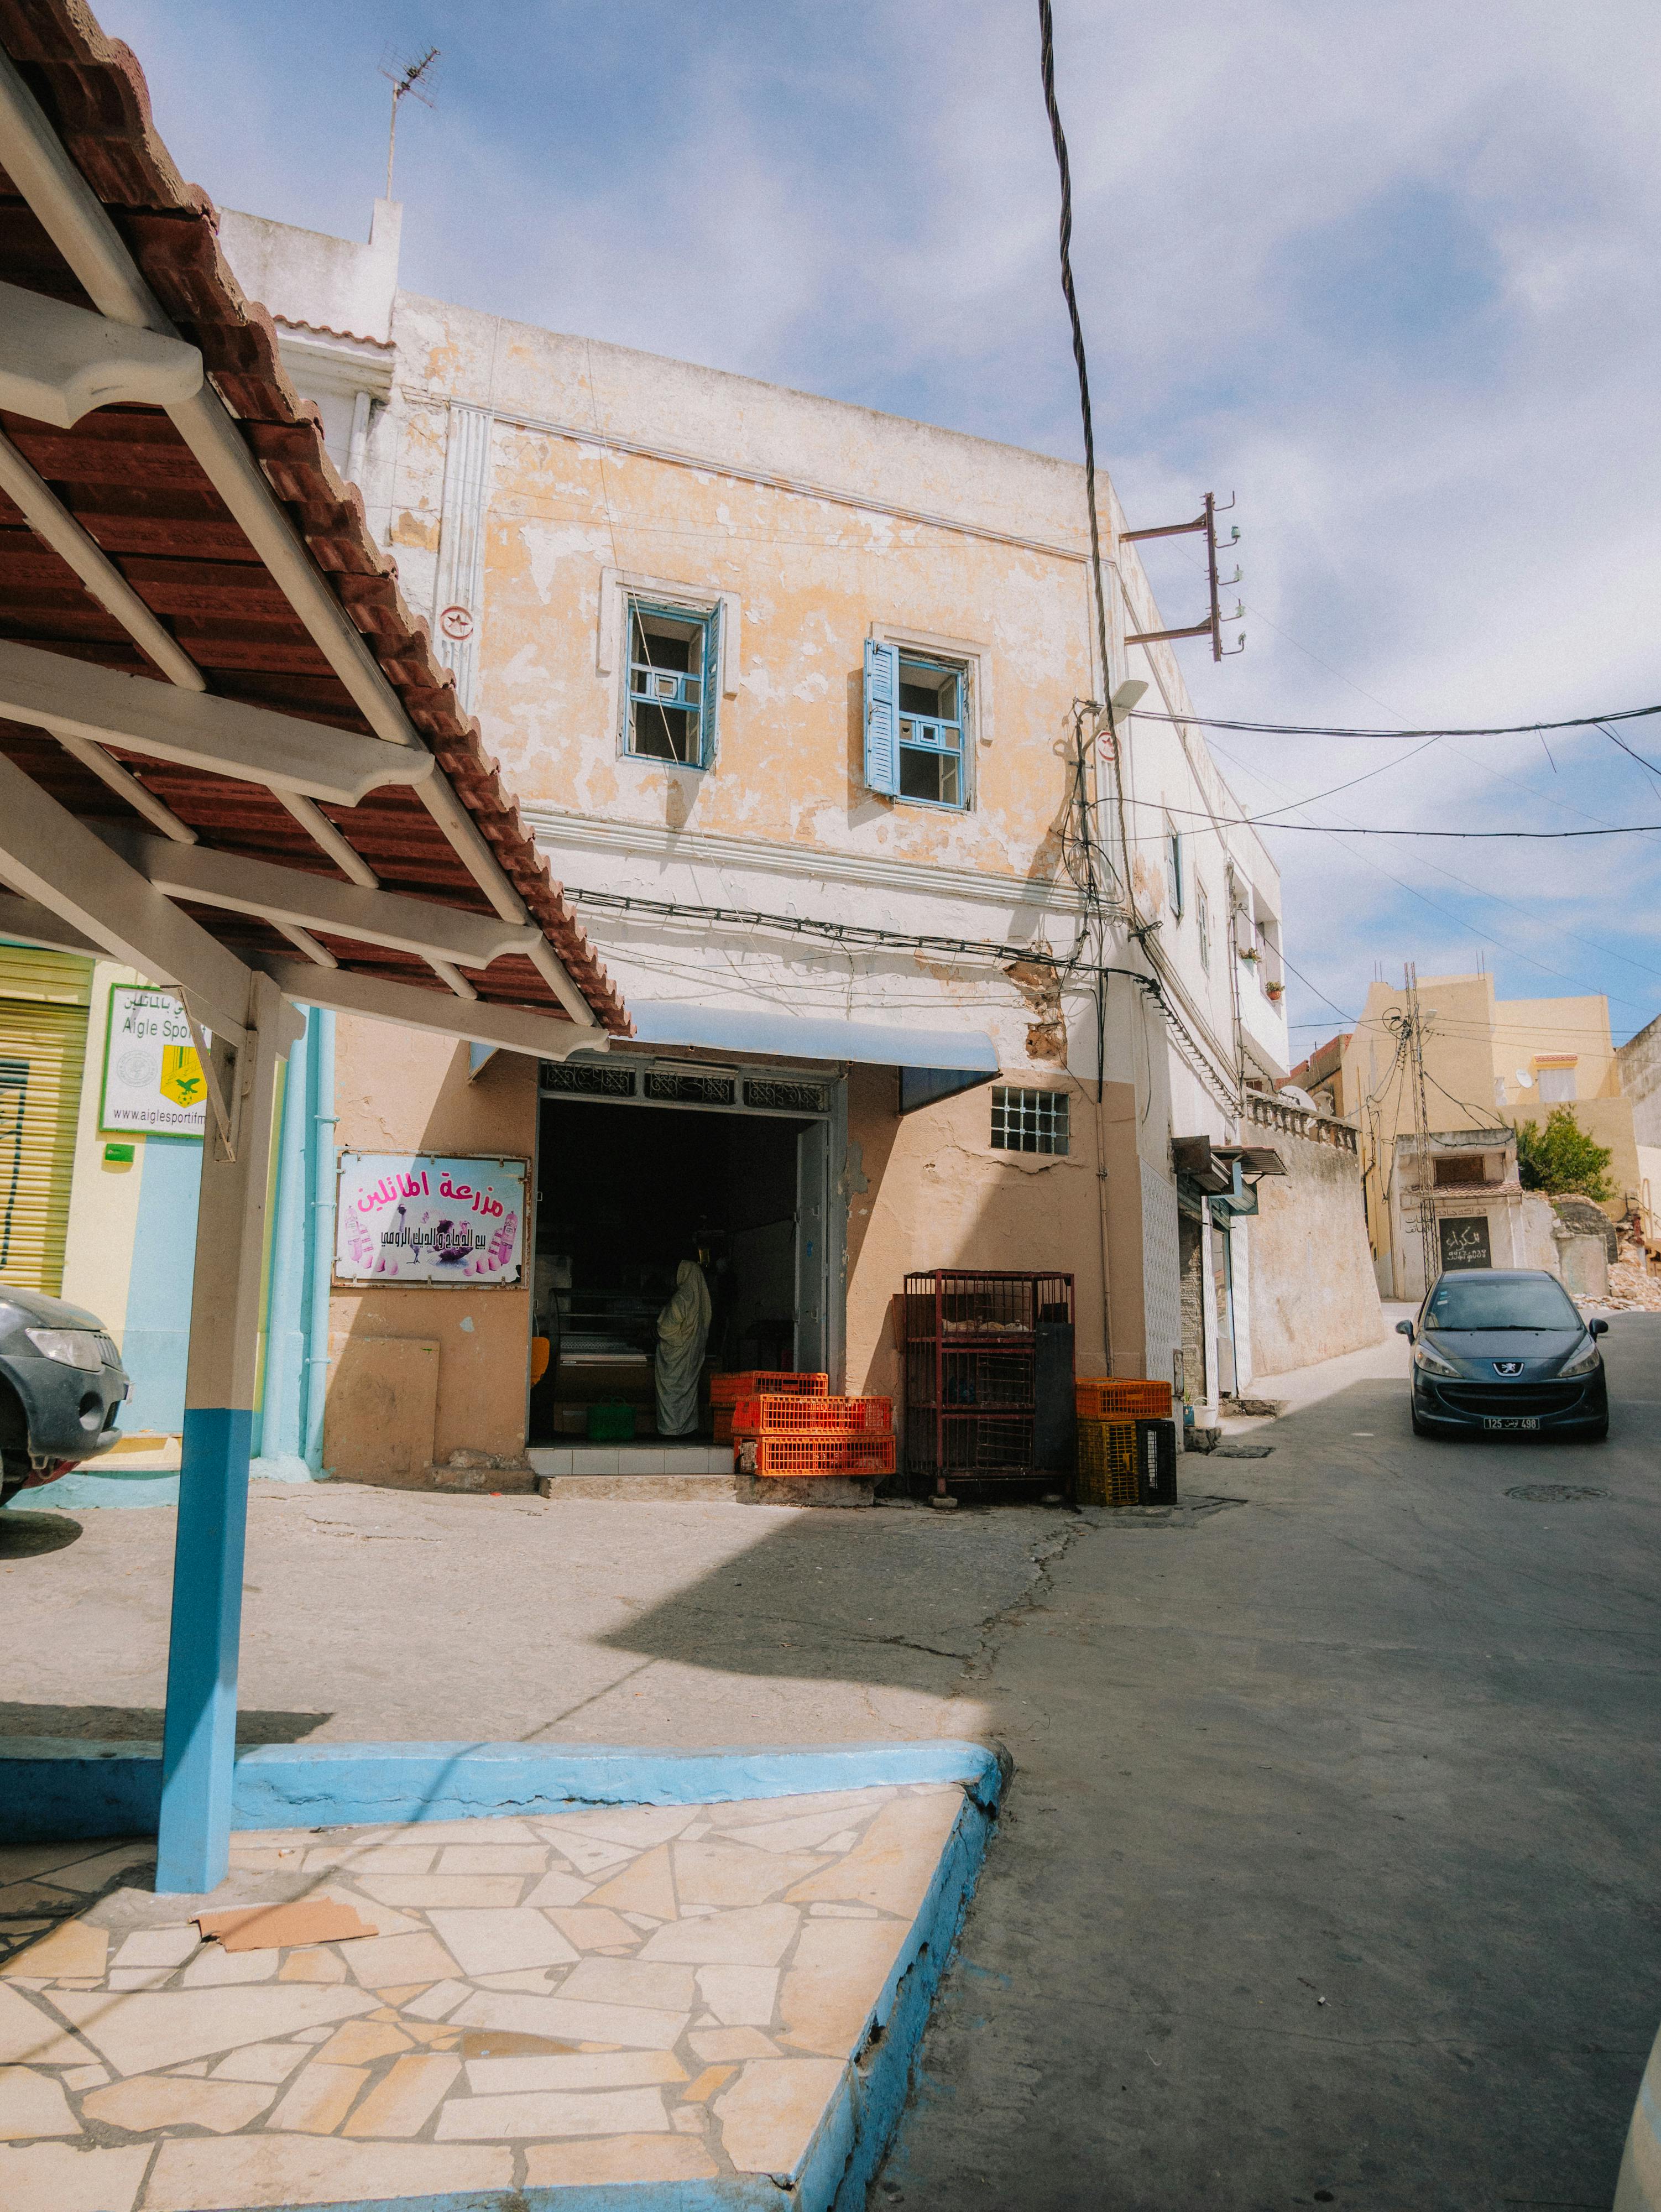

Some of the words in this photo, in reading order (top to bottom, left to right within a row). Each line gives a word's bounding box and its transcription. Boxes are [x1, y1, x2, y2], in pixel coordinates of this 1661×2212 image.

[122, 1017, 158, 1039] Aigle
[358, 1171, 430, 1213] الماتلين
[440, 1172, 504, 1218] مزرعة
[381, 1227, 410, 1247] الرومي
[413, 1228, 437, 1248] الديك
[446, 1229, 473, 1248] الدجاج
[475, 1235, 485, 1250] بيع
[1488, 1419, 1502, 1428] 125
[1521, 1419, 1536, 1428] 498
